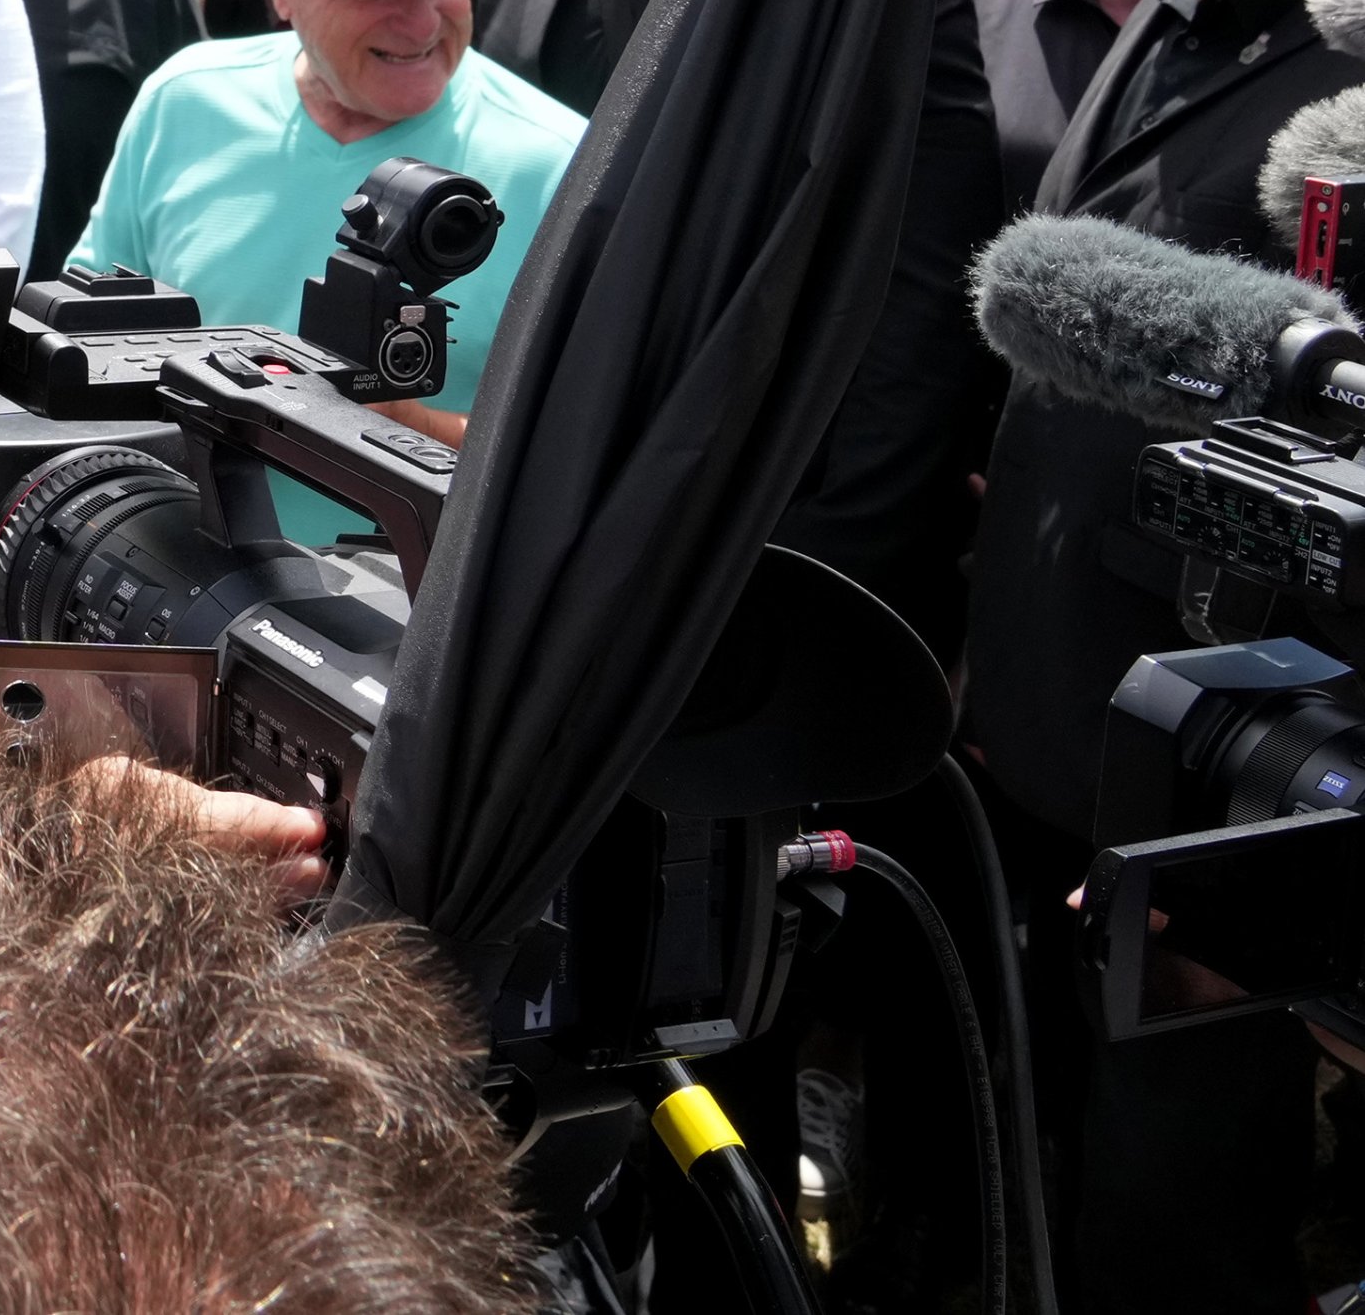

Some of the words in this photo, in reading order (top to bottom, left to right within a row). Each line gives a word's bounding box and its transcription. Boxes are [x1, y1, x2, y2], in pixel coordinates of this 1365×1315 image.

[353, 374, 378, 383] AUDIO
[353, 383, 374, 392] INPUT
[1167, 373, 1223, 393] SONY
[1318, 384, 1365, 410] ONY
[252, 617, 325, 668] Panasonic
